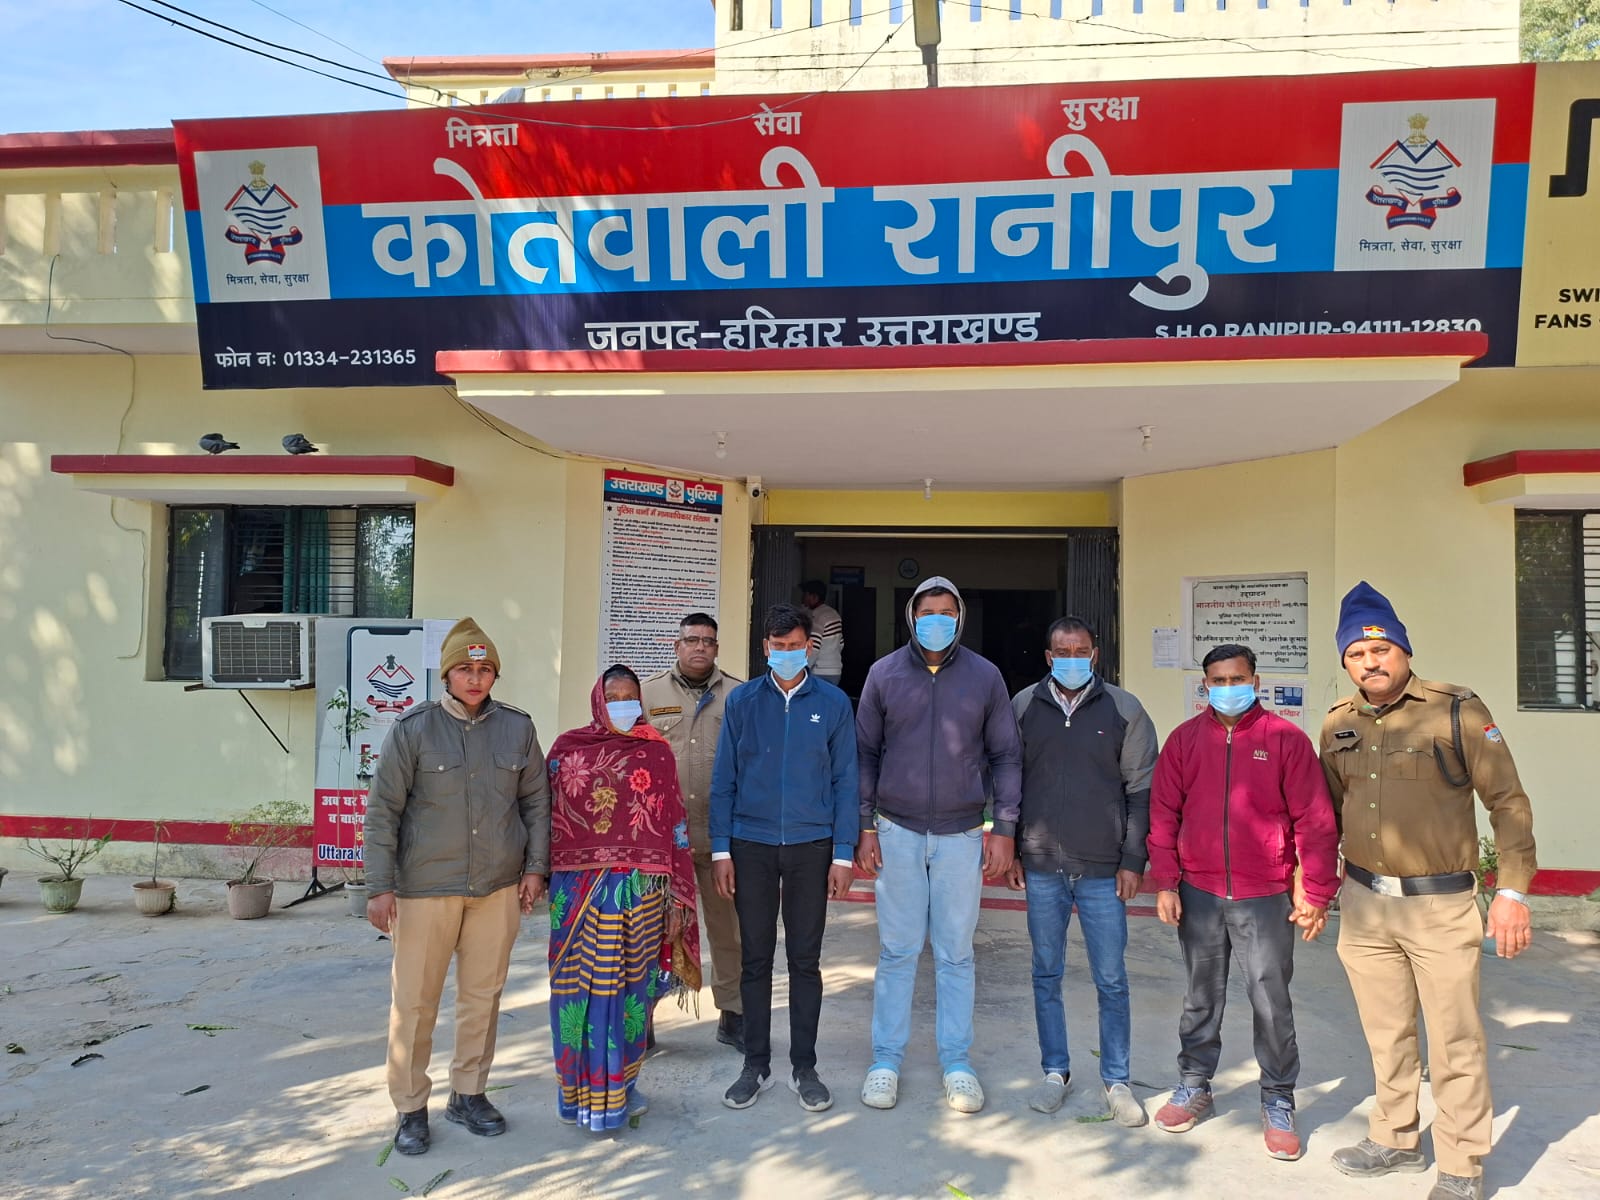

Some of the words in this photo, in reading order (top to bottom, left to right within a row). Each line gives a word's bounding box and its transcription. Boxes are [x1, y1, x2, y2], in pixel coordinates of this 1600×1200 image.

[445, 117, 519, 148] मित्रता
[753, 103, 802, 136] सेवा
[1061, 96, 1139, 131] सुरक्षा
[361, 145, 836, 288] कोतवाली
[873, 133, 1293, 312] रानीपुर
[1359, 239, 1396, 252] मित्रता,
[1401, 238, 1426, 252] सेवा,
[1431, 240, 1463, 254] सुरक्षा
[226, 273, 257, 286] मित्रता,
[259, 272, 281, 285] सेवा,
[284, 273, 310, 287] सुरक्षा
[584, 305, 846, 351] जनपद-हरिद्वार
[857, 312, 1041, 346] उत्तराखण्ड
[1534, 313, 1592, 329] FANS
[215, 346, 251, 368] फोन
[283, 349, 417, 367] 01334-231365
[610, 477, 665, 496] उत्तराखण्ड
[686, 484, 717, 504] पुलिस
